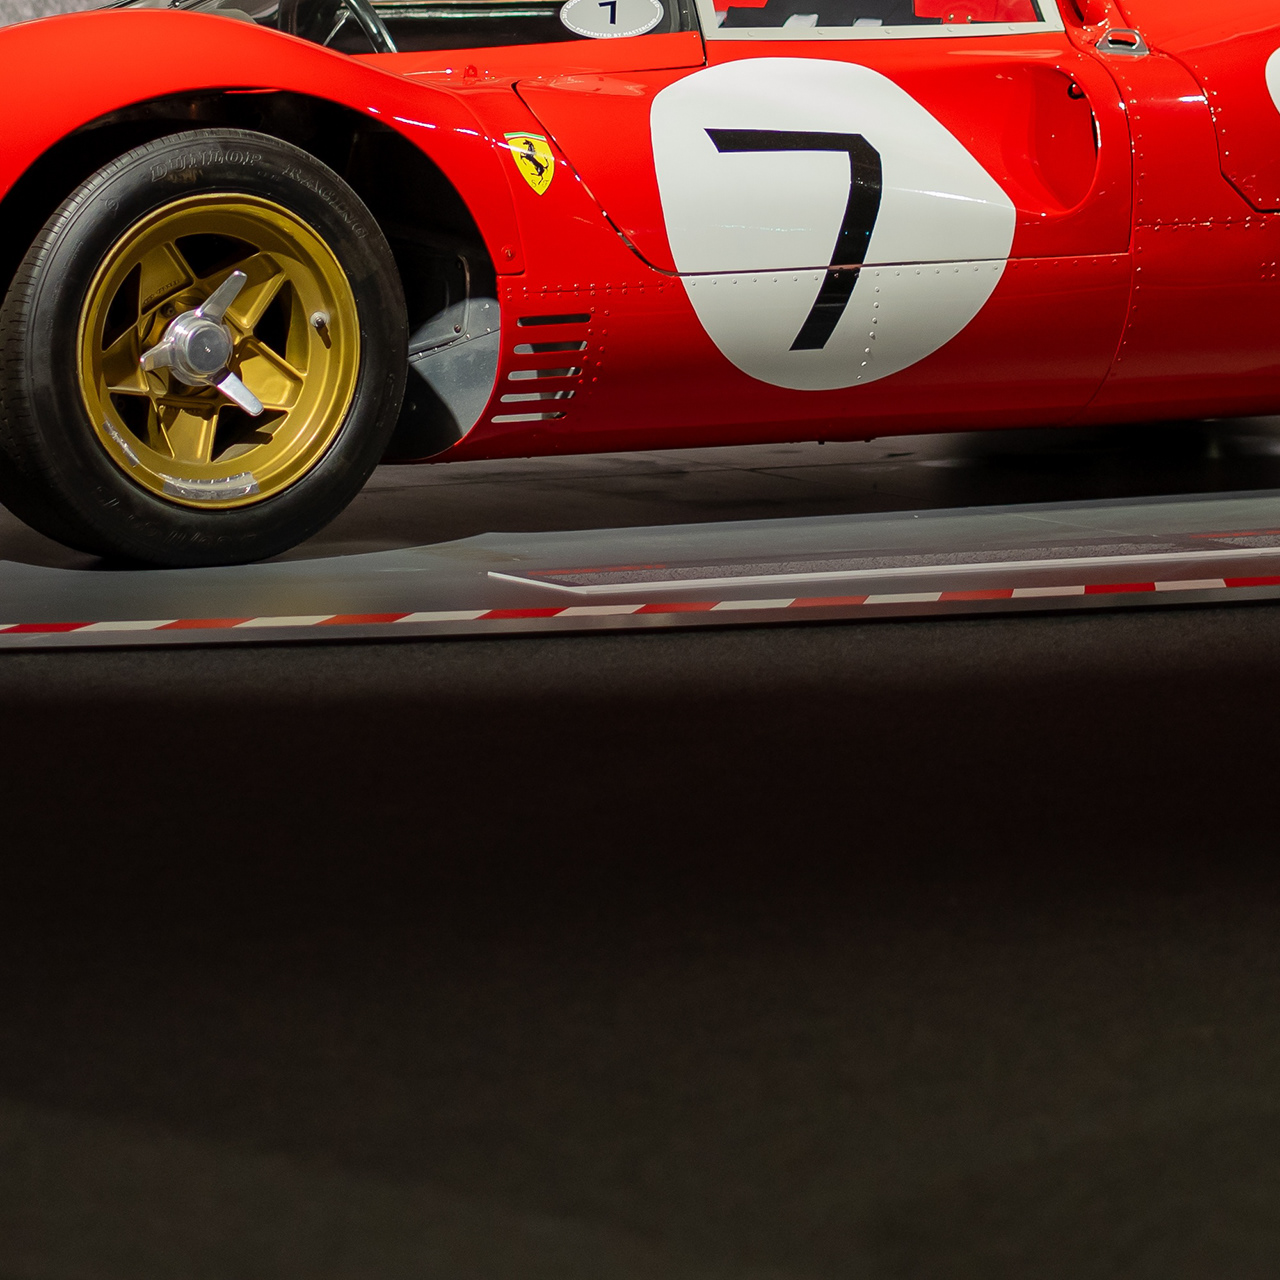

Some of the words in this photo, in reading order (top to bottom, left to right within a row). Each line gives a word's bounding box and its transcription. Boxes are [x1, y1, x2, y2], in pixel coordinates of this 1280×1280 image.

[598, 0, 617, 25] 7
[575, 26, 612, 38] PRESENTED
[149, 148, 262, 183] DUNLOP
[703, 127, 883, 351] 7
